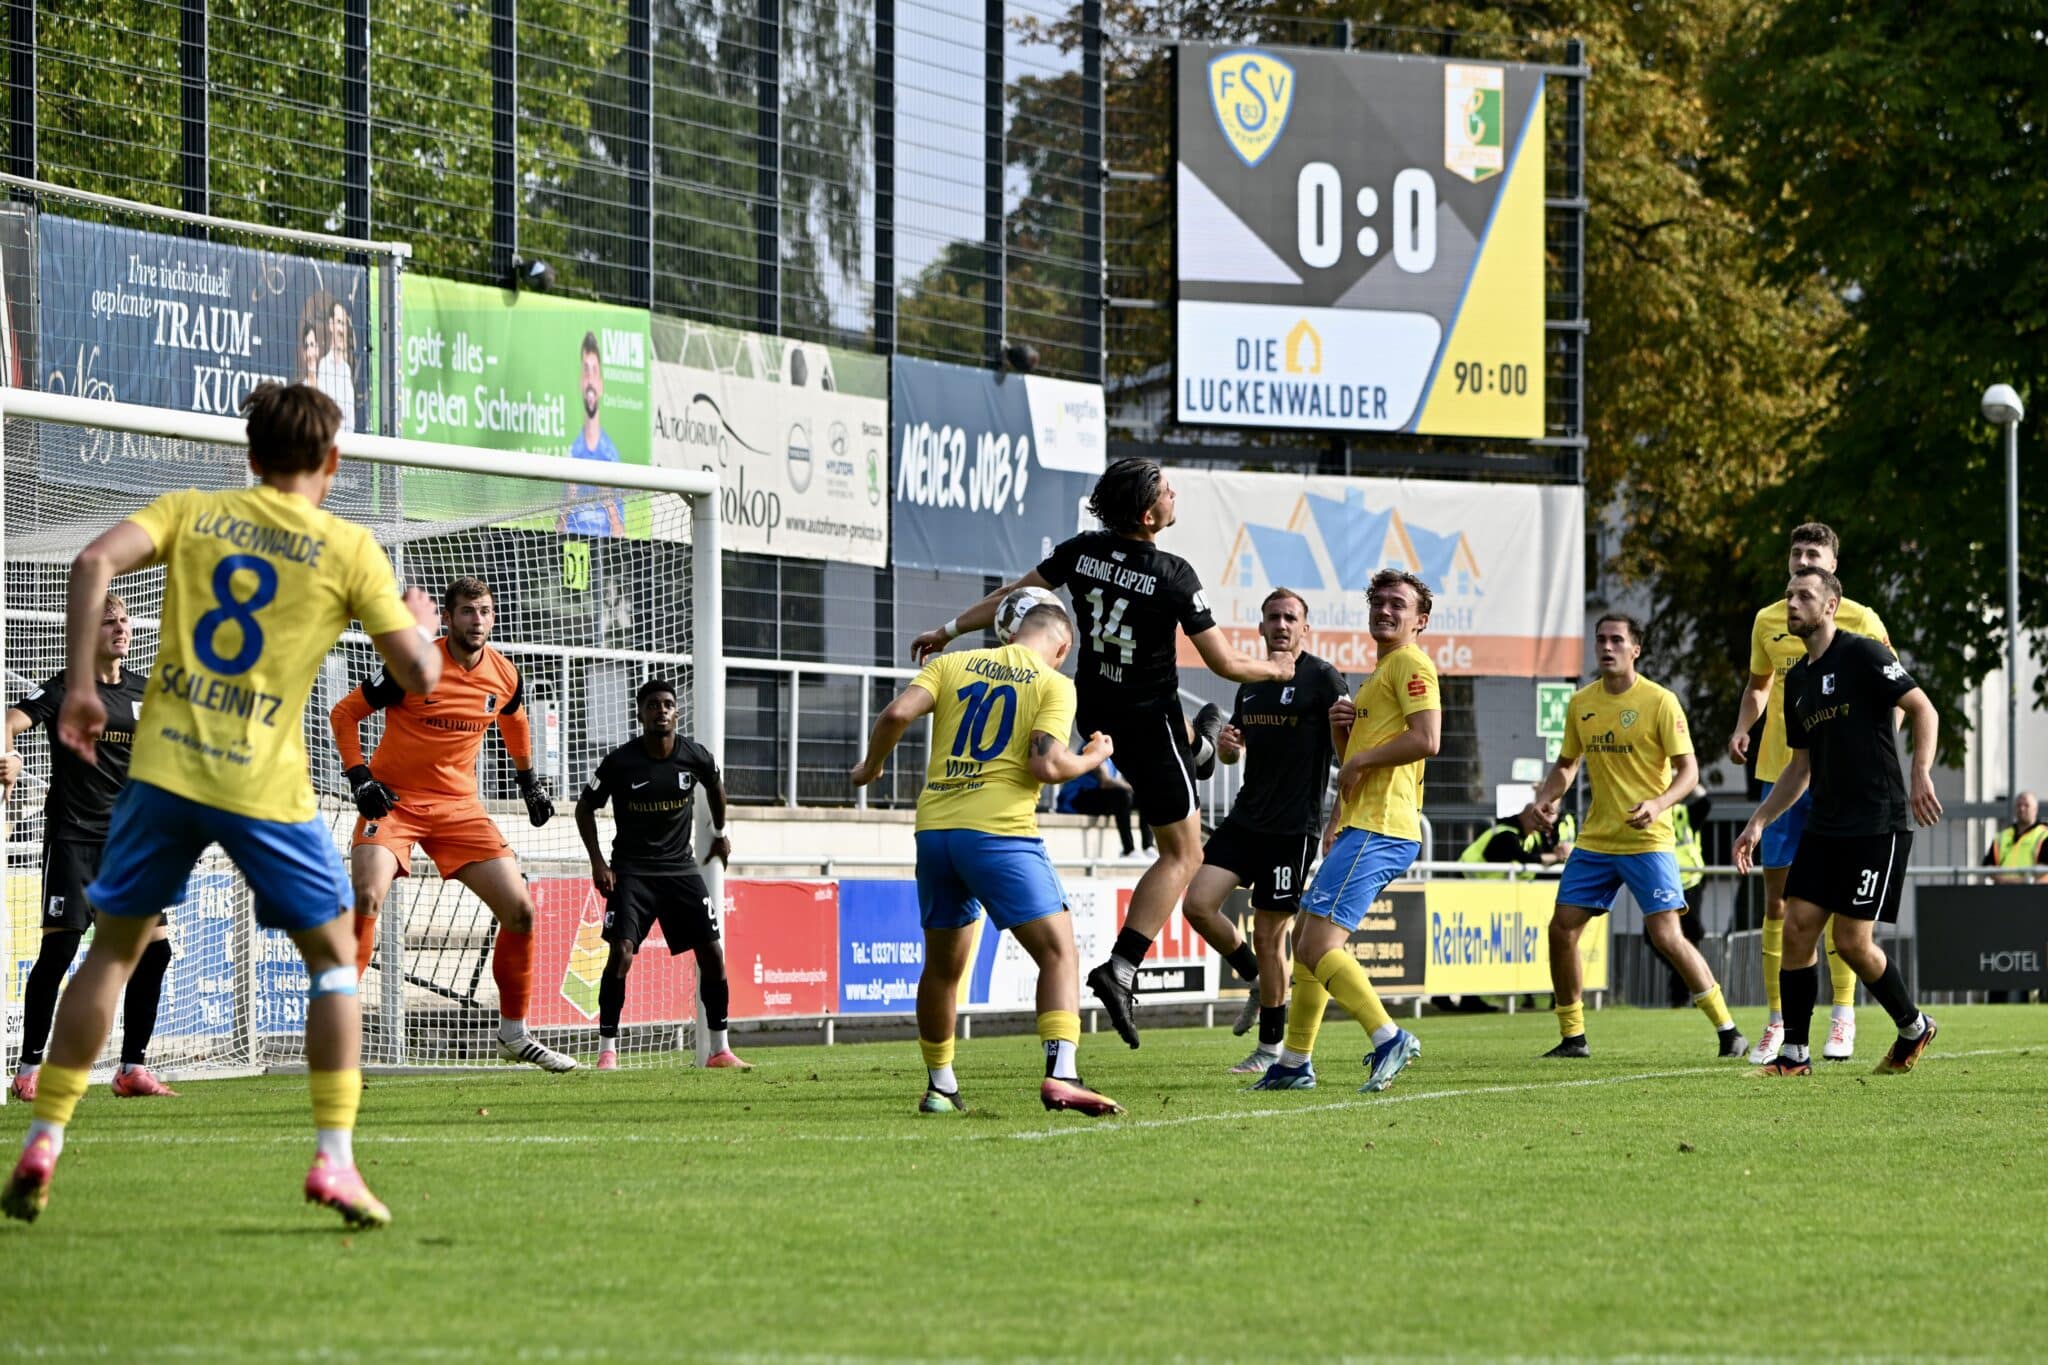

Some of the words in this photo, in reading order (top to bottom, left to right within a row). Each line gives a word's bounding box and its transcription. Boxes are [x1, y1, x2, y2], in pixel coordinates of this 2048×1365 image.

[1297, 160, 1438, 274] 0:0
[128, 255, 157, 287] Ihre
[92, 284, 152, 321] geplante
[153, 298, 262, 357] TRAUM-
[407, 327, 445, 376] gebt
[452, 332, 484, 374] alles
[1236, 338, 1278, 372] DIE
[191, 355, 288, 418] KÜC
[1185, 377, 1388, 420] LUCKENWALDER
[1454, 361, 1527, 396] 90:00
[416, 379, 468, 435] geben
[474, 384, 566, 438] Sicherheit!
[969, 431, 1029, 517] JOB?
[194, 512, 326, 568] LUCKENWALDE
[1075, 554, 1115, 583] CHEMIE
[1113, 566, 1157, 595] LEIPZIG
[192, 553, 279, 676] 8
[1085, 587, 1138, 665] 14
[965, 656, 1039, 685] LUCKENWALDE
[957, 680, 1018, 763] 10
[1273, 866, 1292, 890] 18
[1857, 869, 1879, 898] 31
[1432, 911, 1538, 965] Reifen-Müller
[1980, 950, 2040, 972] HOTEL
